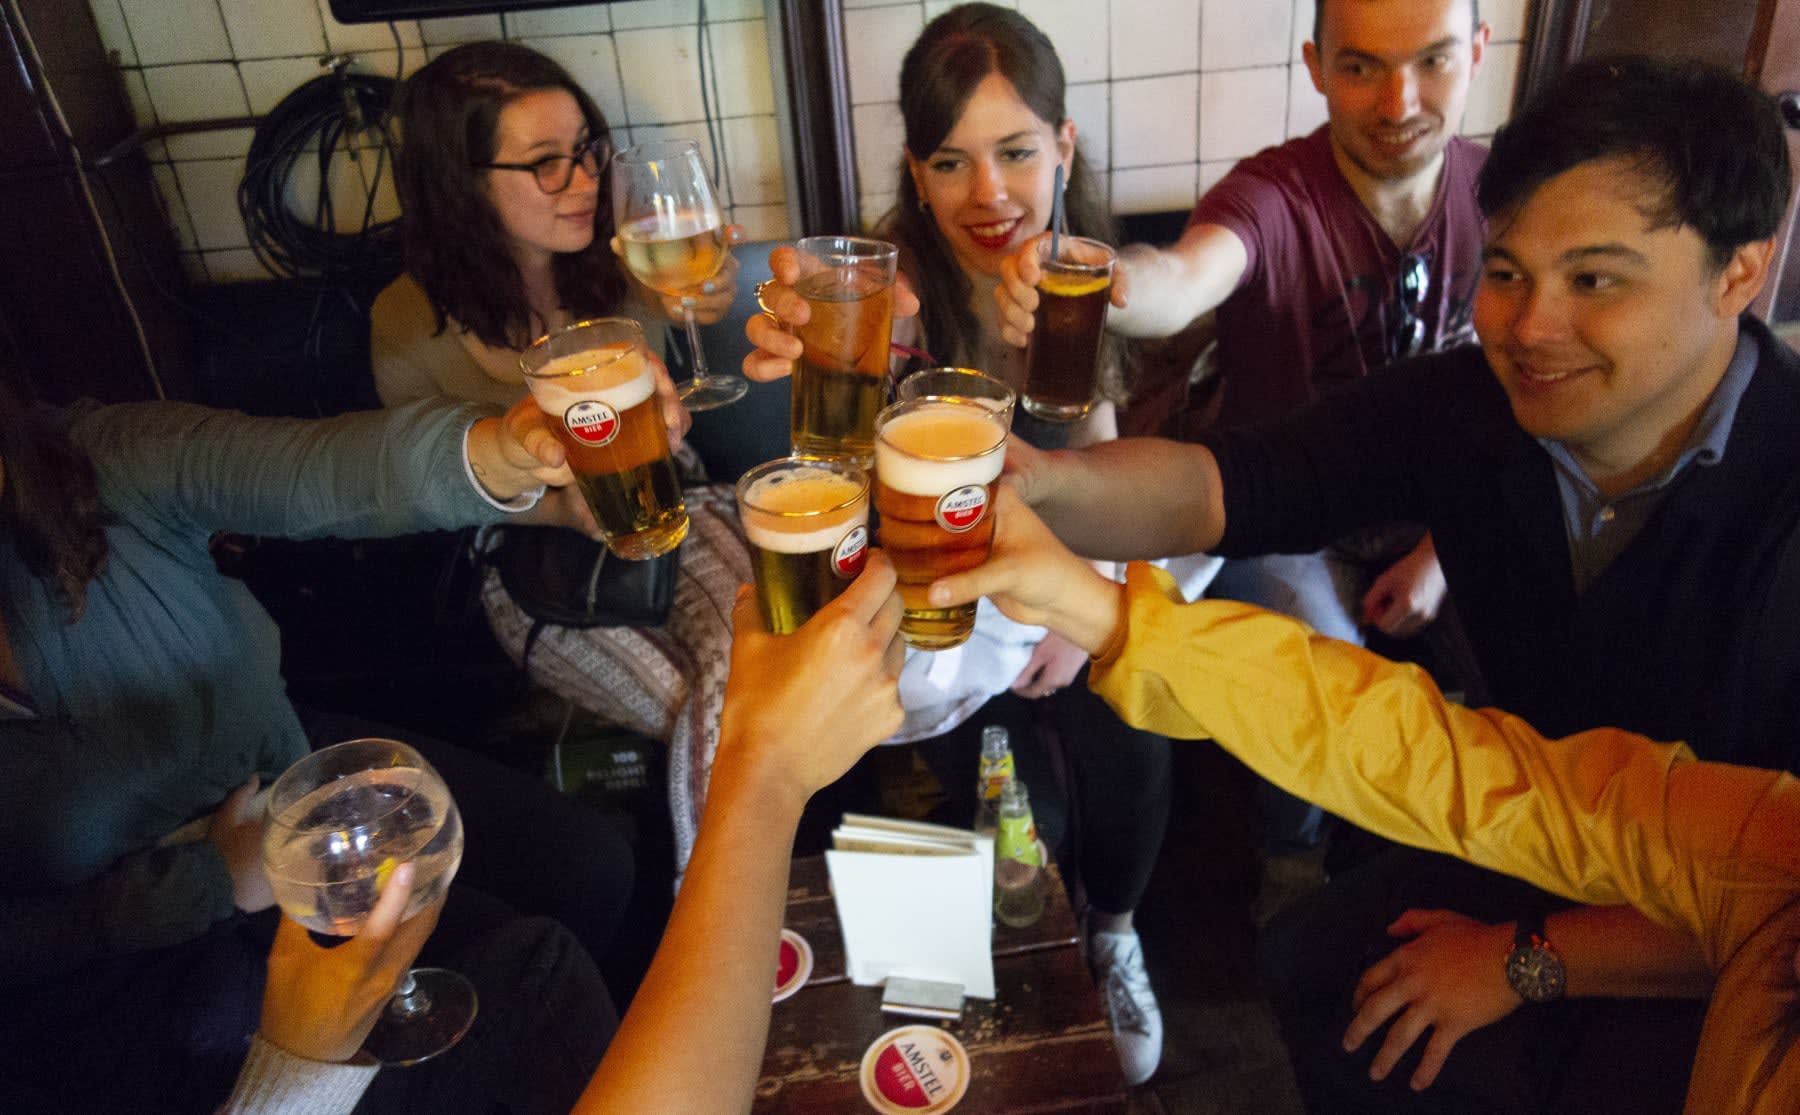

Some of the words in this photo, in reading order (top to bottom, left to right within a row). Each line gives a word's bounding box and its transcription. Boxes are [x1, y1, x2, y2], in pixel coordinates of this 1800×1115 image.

[571, 411, 610, 424] AMSTEL
[891, 1062, 915, 1092] BIER
[901, 1043, 943, 1097] AMSTEL
